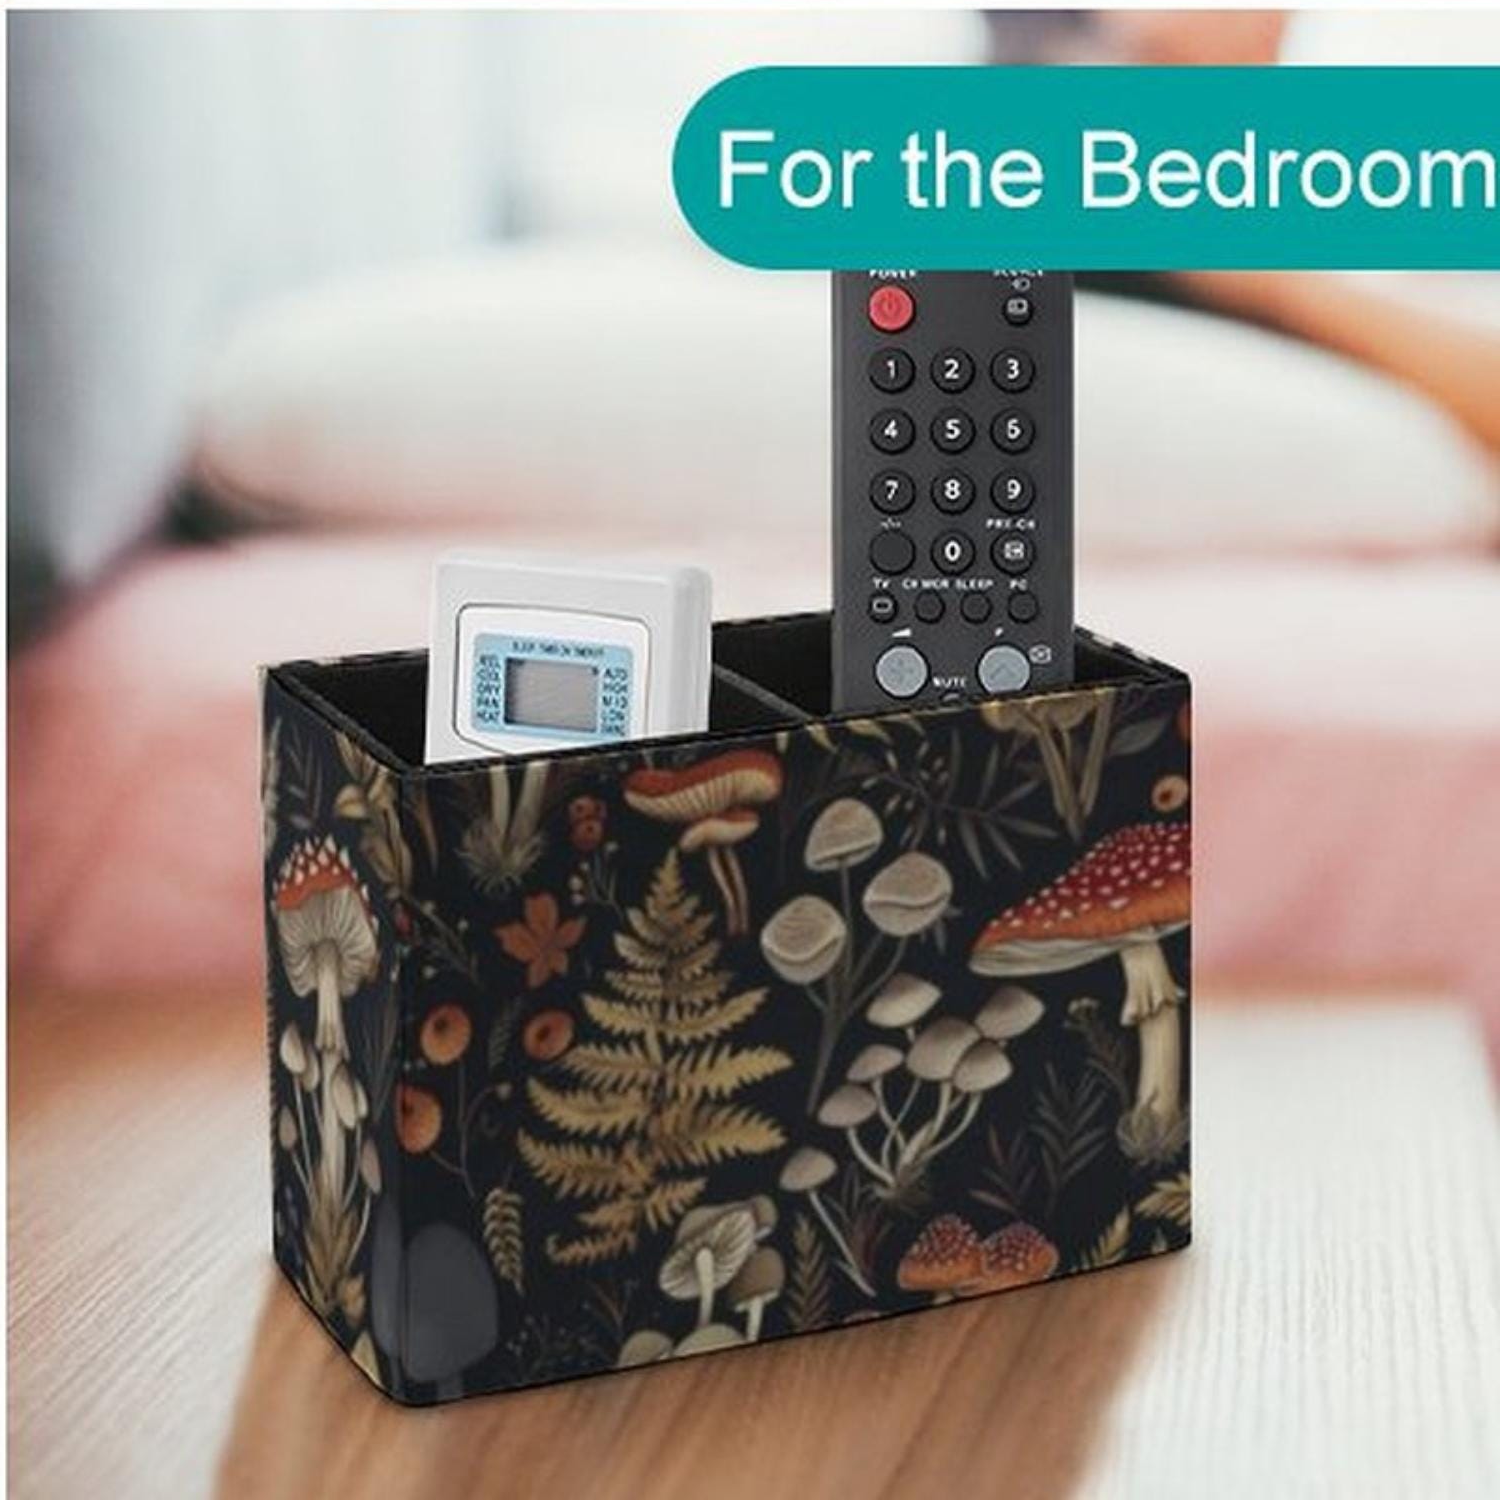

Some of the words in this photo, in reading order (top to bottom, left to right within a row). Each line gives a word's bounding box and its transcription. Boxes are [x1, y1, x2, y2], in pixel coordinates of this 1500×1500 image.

[887, 359, 897, 378] 1
[944, 358, 960, 380] 2
[1007, 358, 1020, 380] 3
[884, 419, 898, 438] 4
[945, 418, 961, 440] 5
[1007, 418, 1021, 440] 6
[885, 480, 899, 500] 7
[944, 479, 961, 500] 8
[1007, 479, 1022, 500] 9
[944, 540, 961, 562] 0
